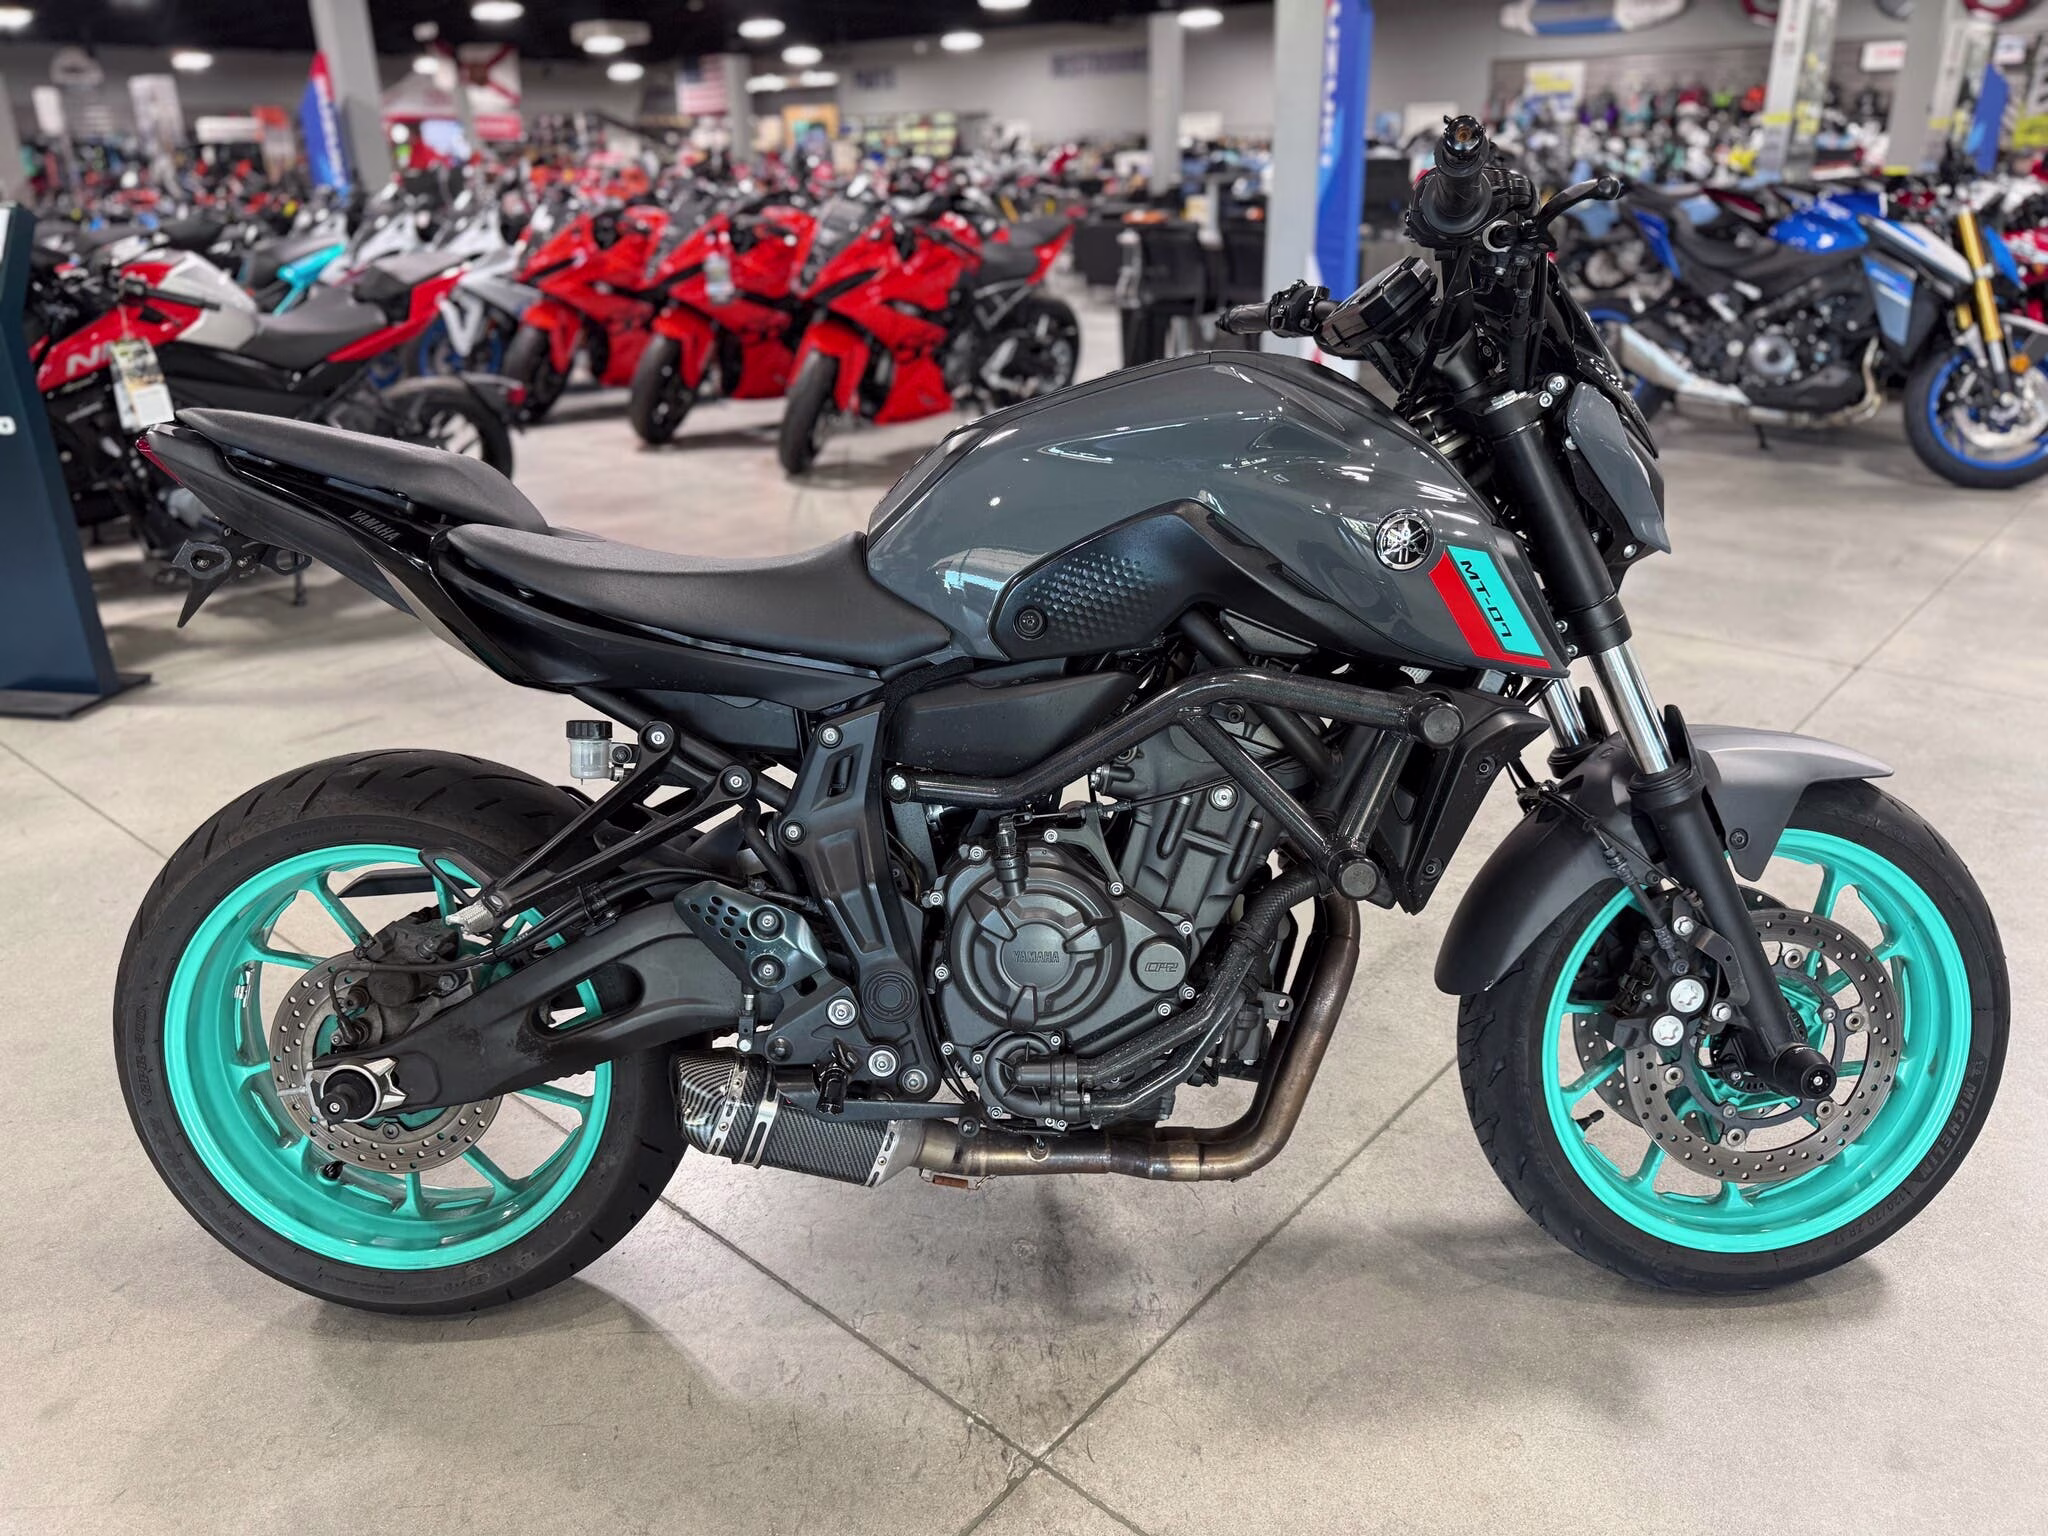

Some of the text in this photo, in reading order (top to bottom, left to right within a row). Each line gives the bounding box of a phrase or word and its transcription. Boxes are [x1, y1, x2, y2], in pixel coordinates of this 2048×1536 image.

[348, 510, 401, 541] YAMAHA
[1461, 560, 1512, 638] MT-07
[1013, 950, 1060, 963] YAMAHA
[1920, 1081, 1977, 1179] MICHELIN
